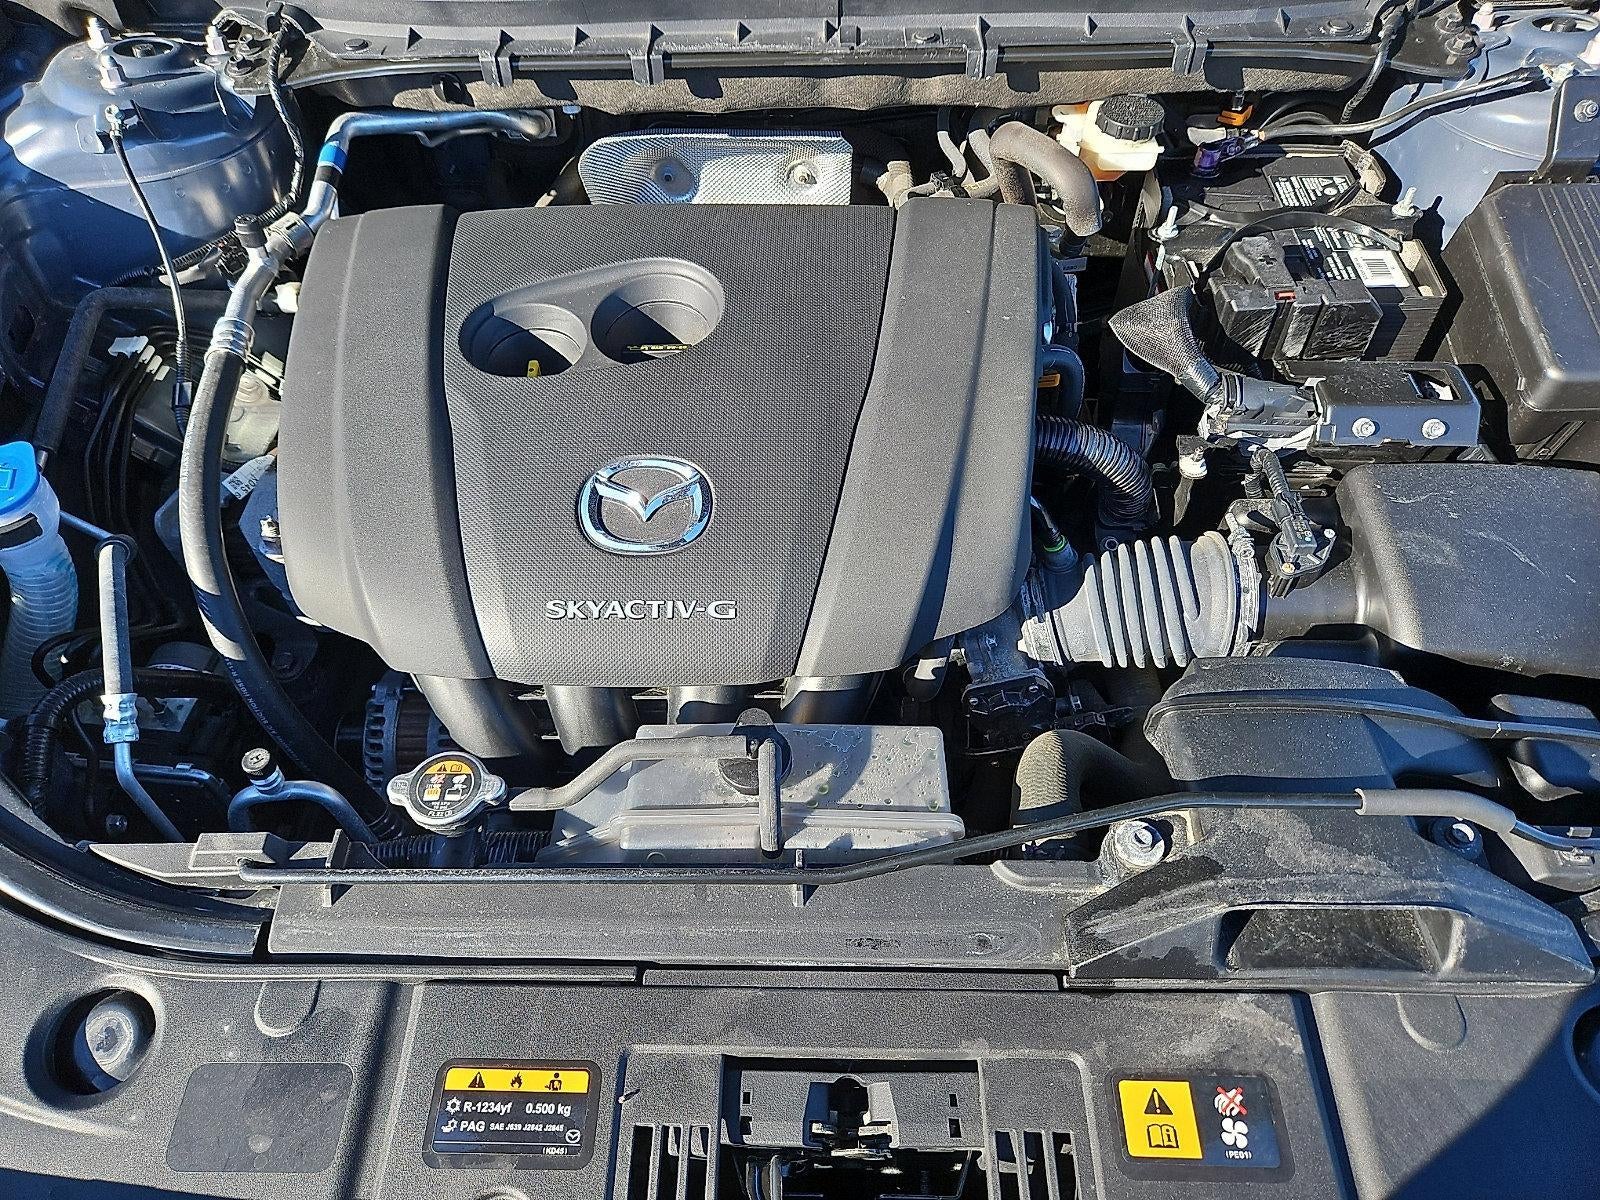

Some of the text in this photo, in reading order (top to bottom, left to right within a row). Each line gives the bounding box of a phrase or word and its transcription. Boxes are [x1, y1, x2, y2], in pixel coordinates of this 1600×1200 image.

[545, 599, 738, 620] SKYACTIV-G
[235, 677, 250, 698] HOSE
[248, 697, 269, 725] SUCTION
[463, 1101, 572, 1117] R-1234yf 0.500 kg
[460, 1120, 486, 1132] PAG
[489, 1122, 505, 1131] SAE
